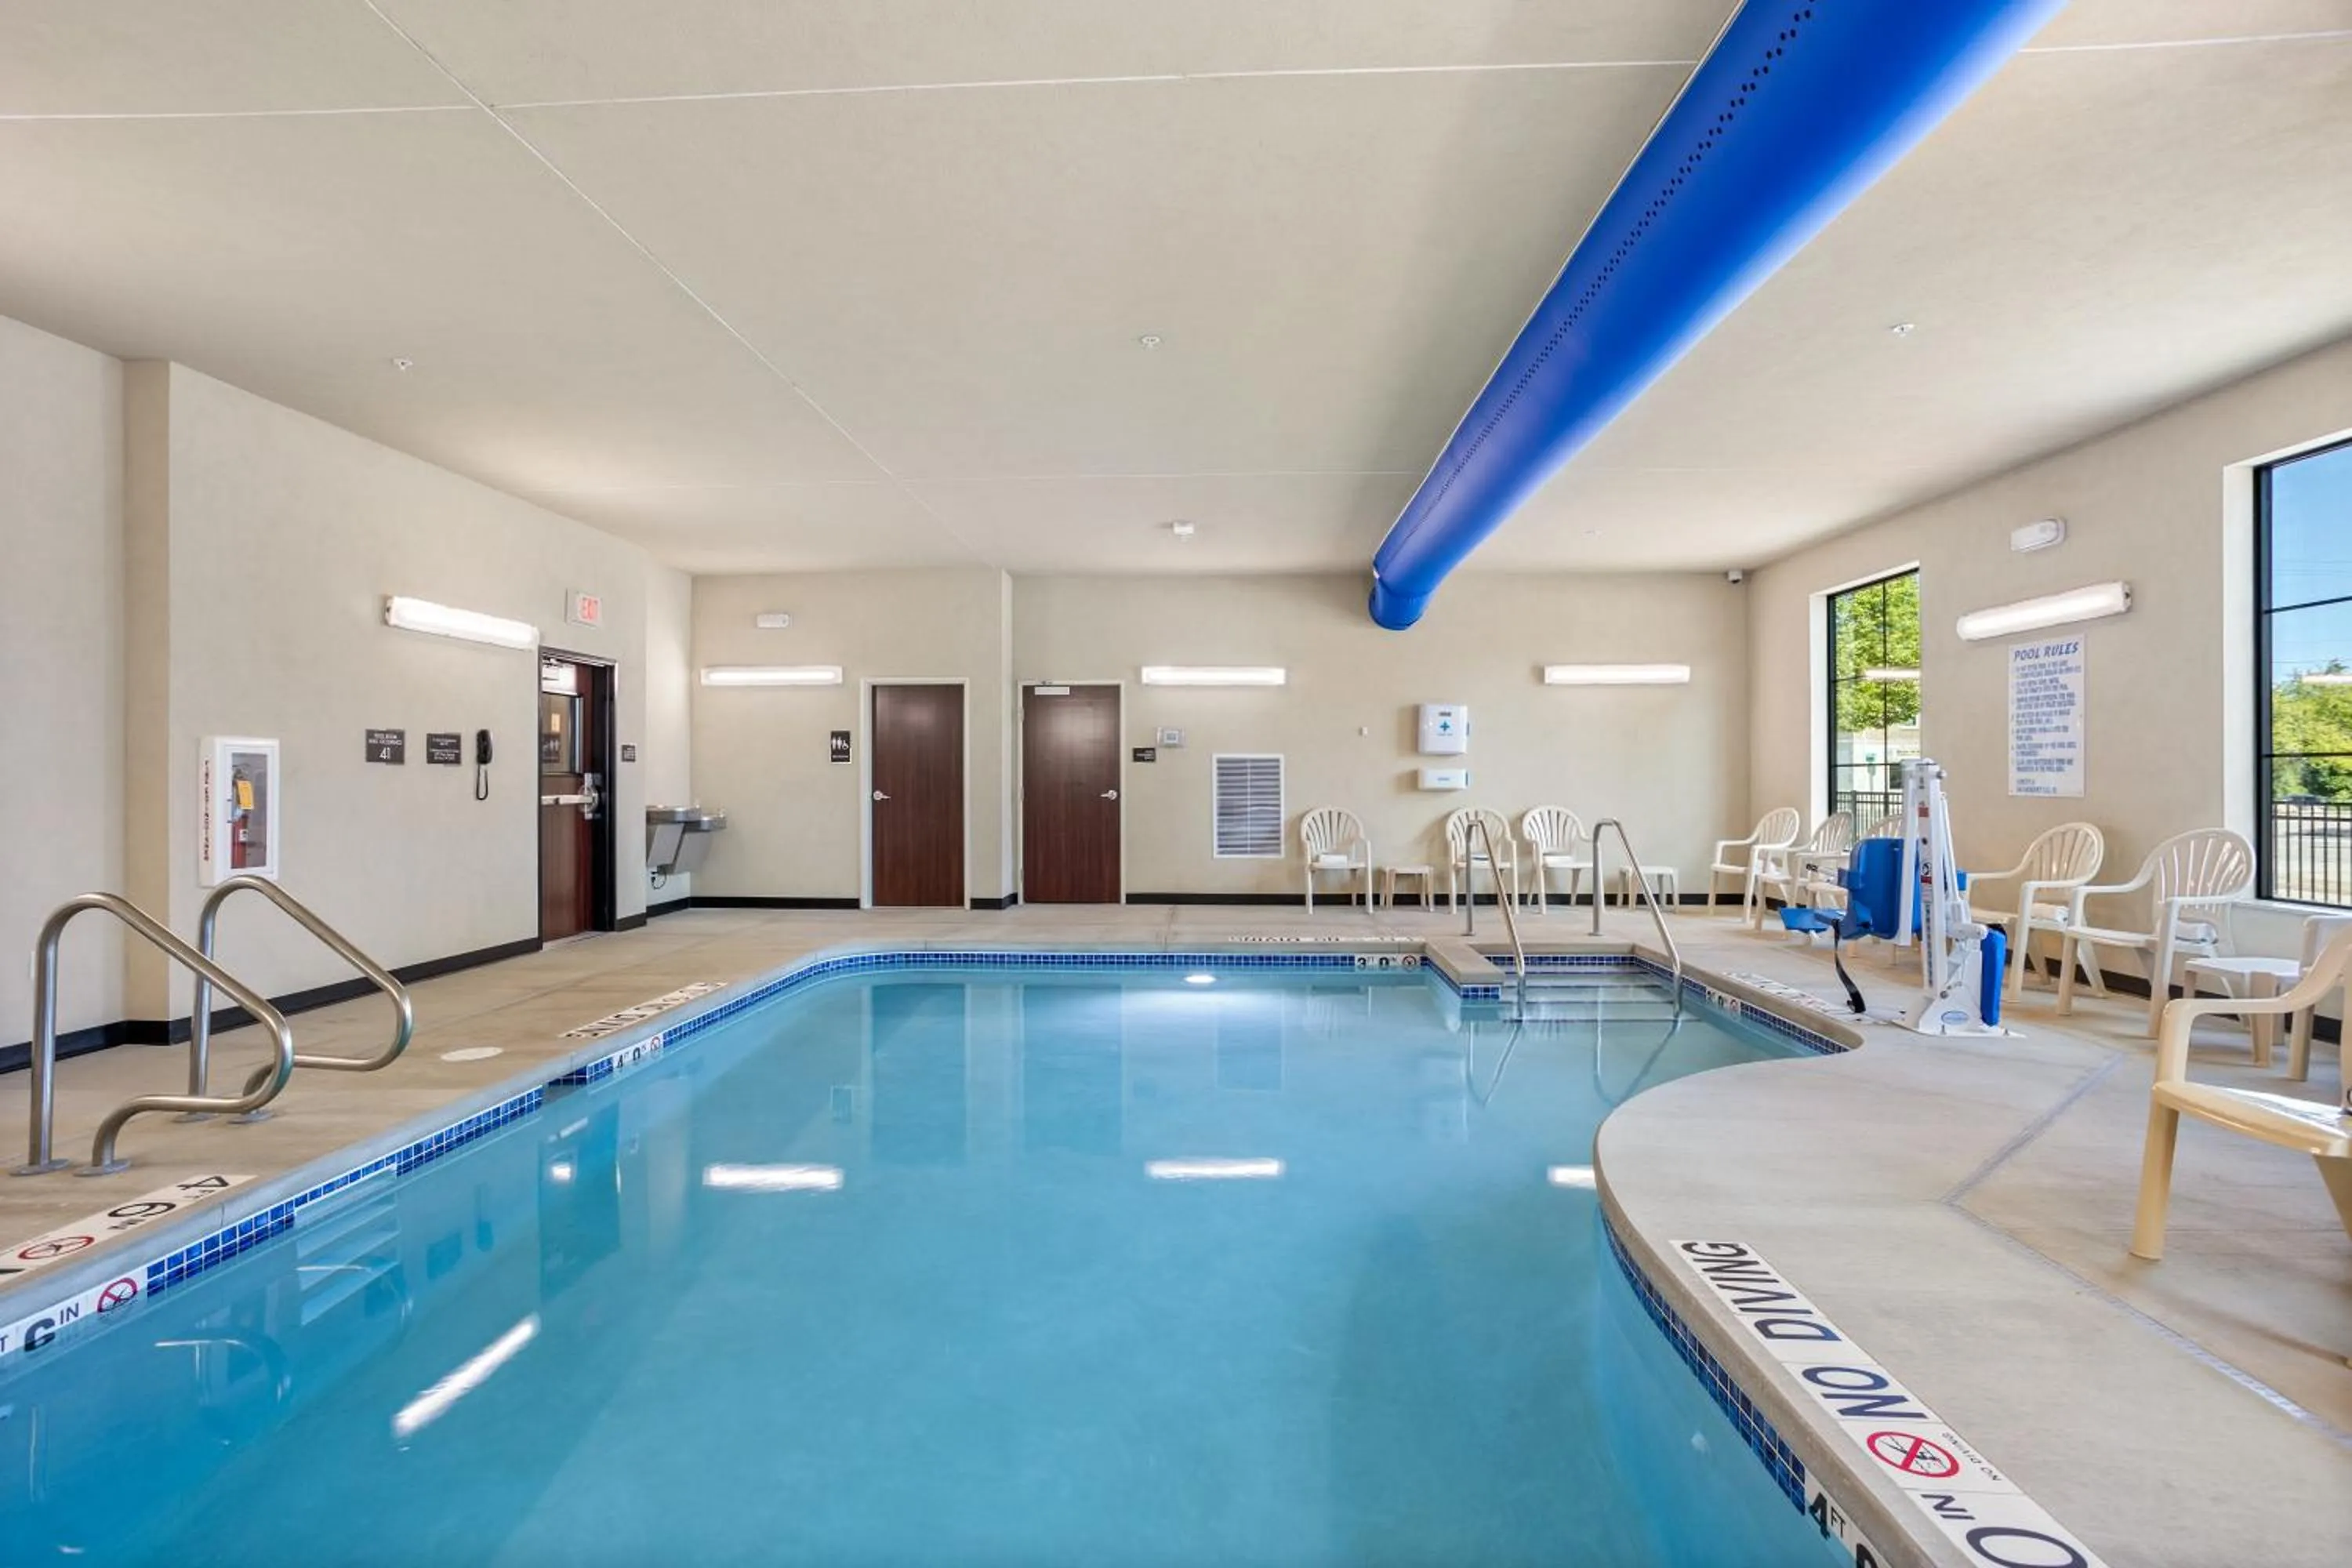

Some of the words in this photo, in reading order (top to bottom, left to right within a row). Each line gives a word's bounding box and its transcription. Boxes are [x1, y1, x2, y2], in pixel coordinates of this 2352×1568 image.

[2013, 648, 2040, 662] POOL
[2044, 641, 2079, 658] RULES
[178, 1175, 230, 1190] 4
[1681, 1242, 1842, 1341] DIVING
[60, 1303, 79, 1325] IN
[1802, 1367, 1929, 1420] NO
[1809, 1492, 1830, 1541] 4
[1831, 1505, 1847, 1539] FT
[1921, 1494, 1976, 1520] IN
